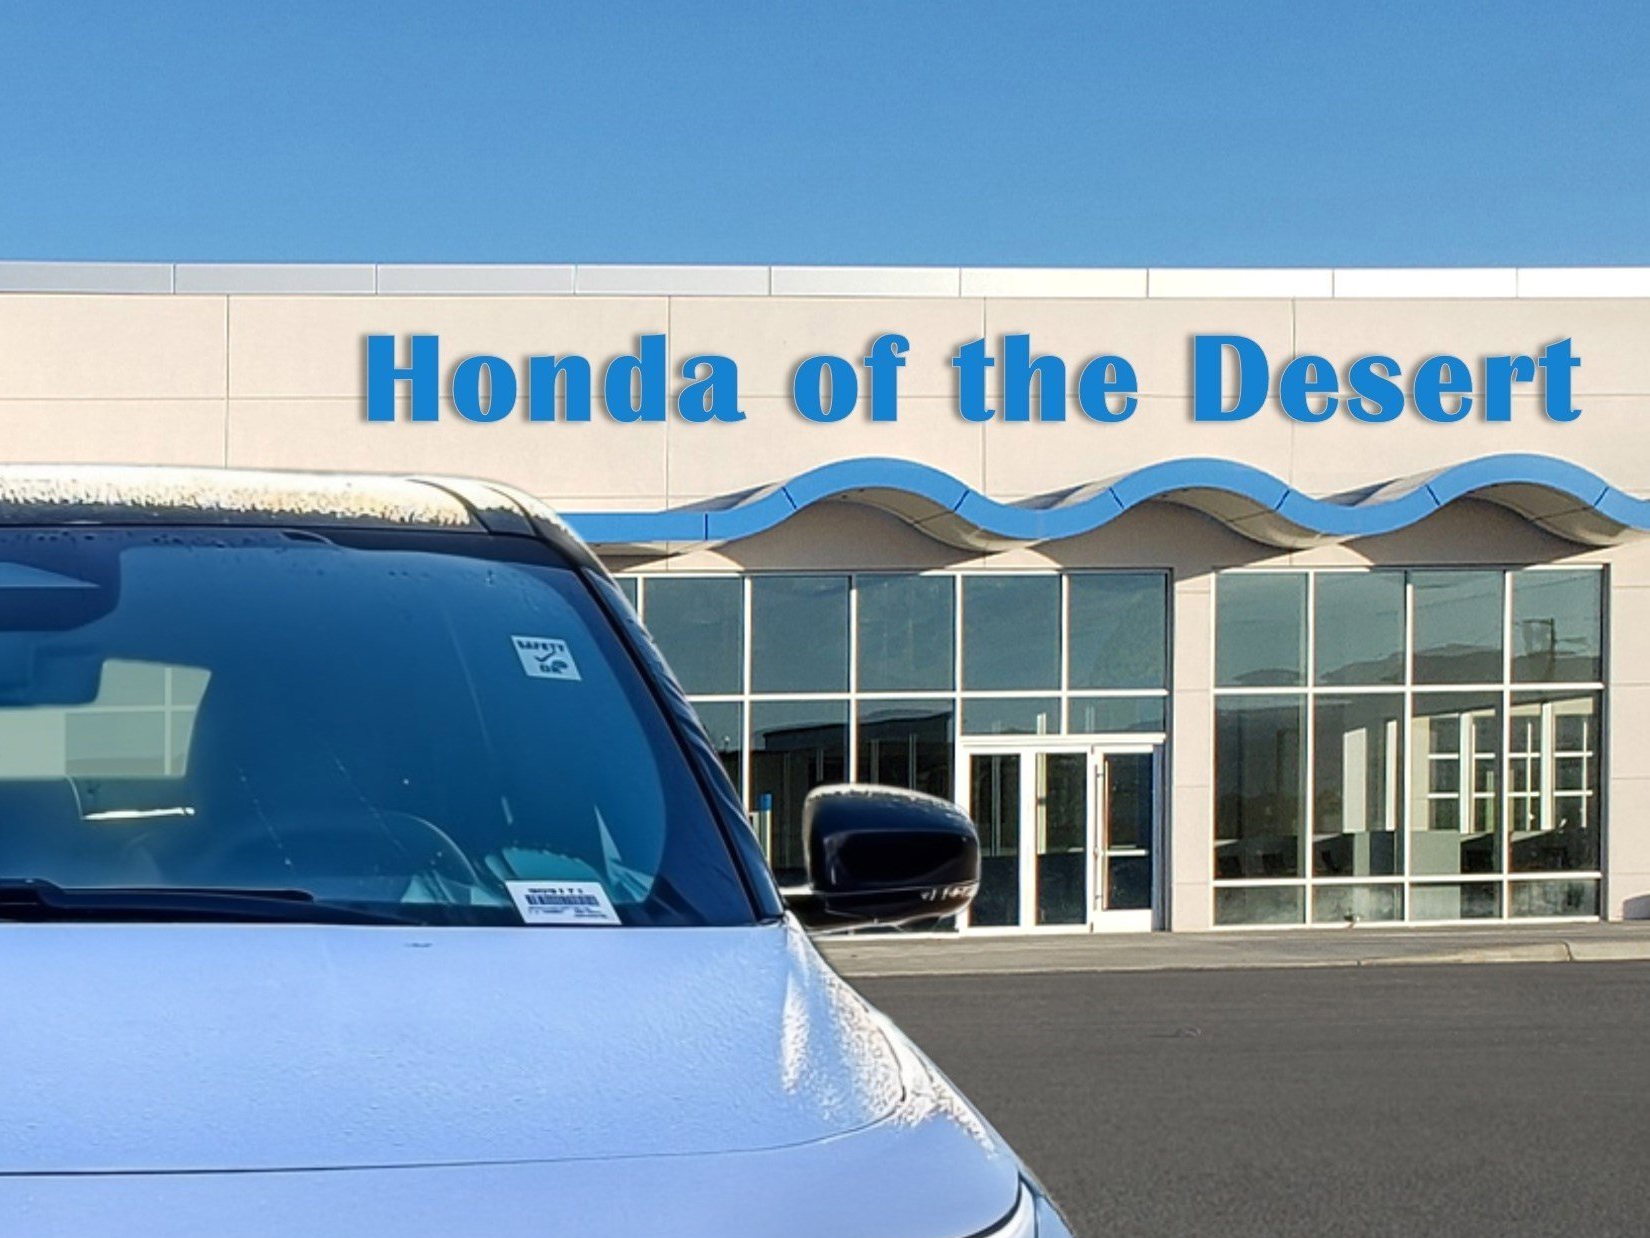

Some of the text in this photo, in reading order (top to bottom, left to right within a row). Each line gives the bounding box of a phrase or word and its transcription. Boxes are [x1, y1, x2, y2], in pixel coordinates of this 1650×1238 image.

[366, 332, 1582, 424] Honda of the Desert
[516, 640, 565, 653] SAFETY
